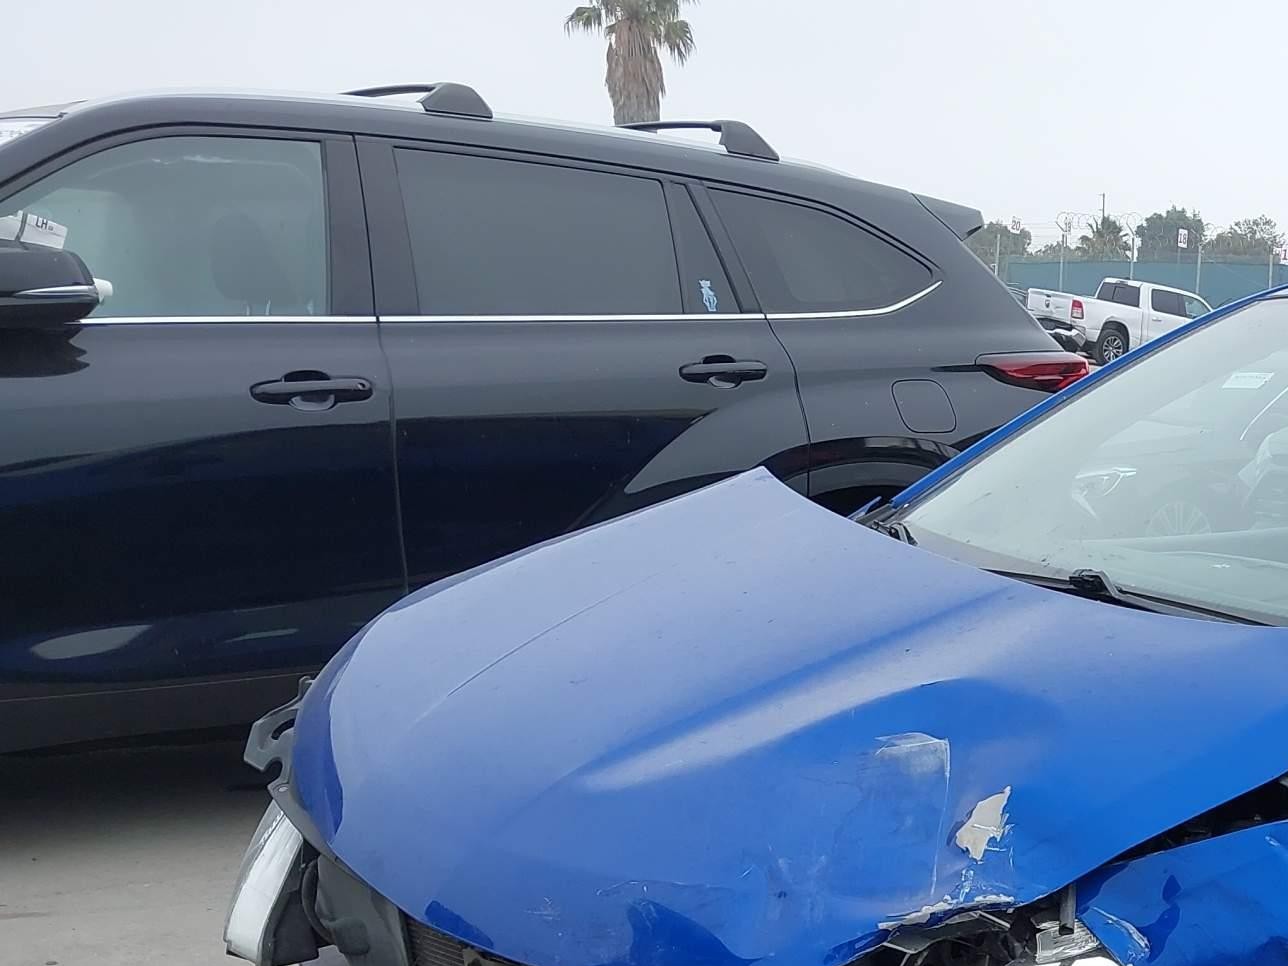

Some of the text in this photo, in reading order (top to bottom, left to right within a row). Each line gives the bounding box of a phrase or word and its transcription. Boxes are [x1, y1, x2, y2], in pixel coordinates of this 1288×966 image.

[36, 216, 48, 229] LH
[1011, 220, 1021, 232] 20
[1178, 233, 1188, 245] 18
